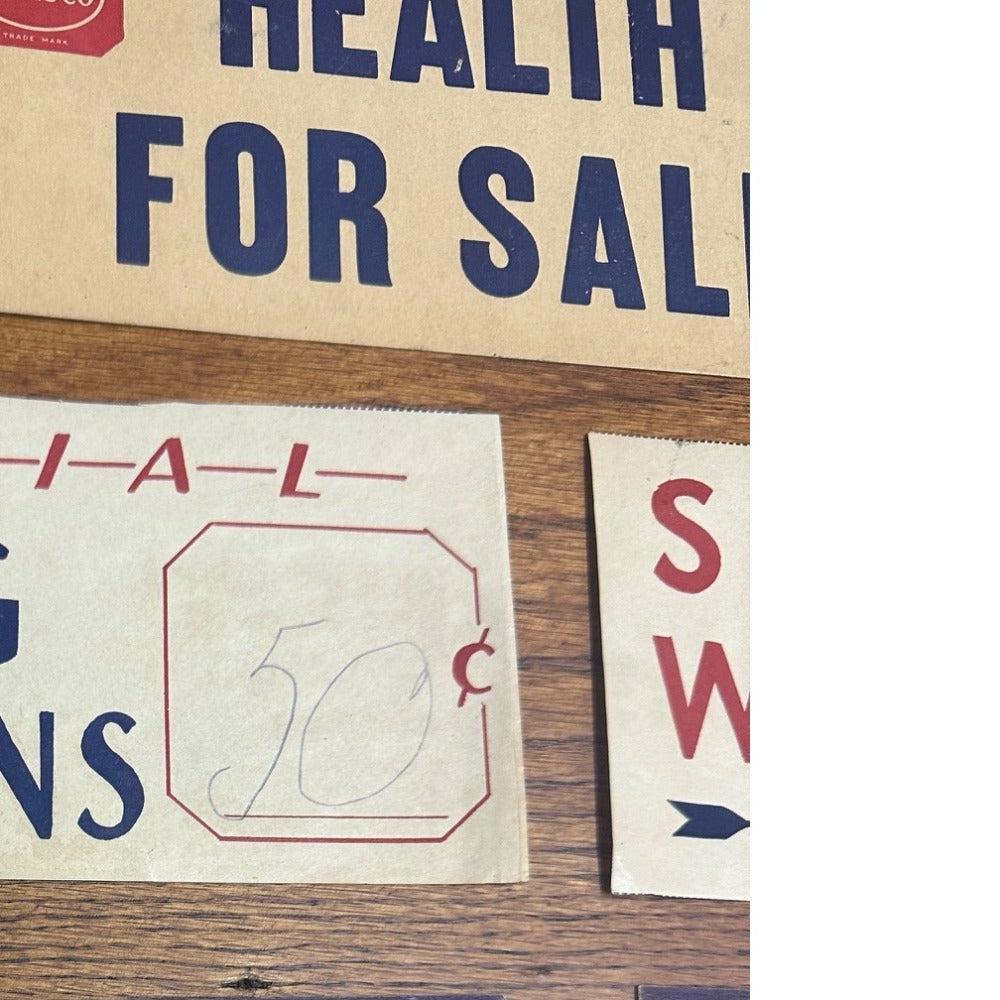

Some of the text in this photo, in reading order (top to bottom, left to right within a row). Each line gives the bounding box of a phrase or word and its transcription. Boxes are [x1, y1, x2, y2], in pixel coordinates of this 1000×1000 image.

[116, 112, 750, 317] FOR SAL
[208, 618, 432, 821] 50
